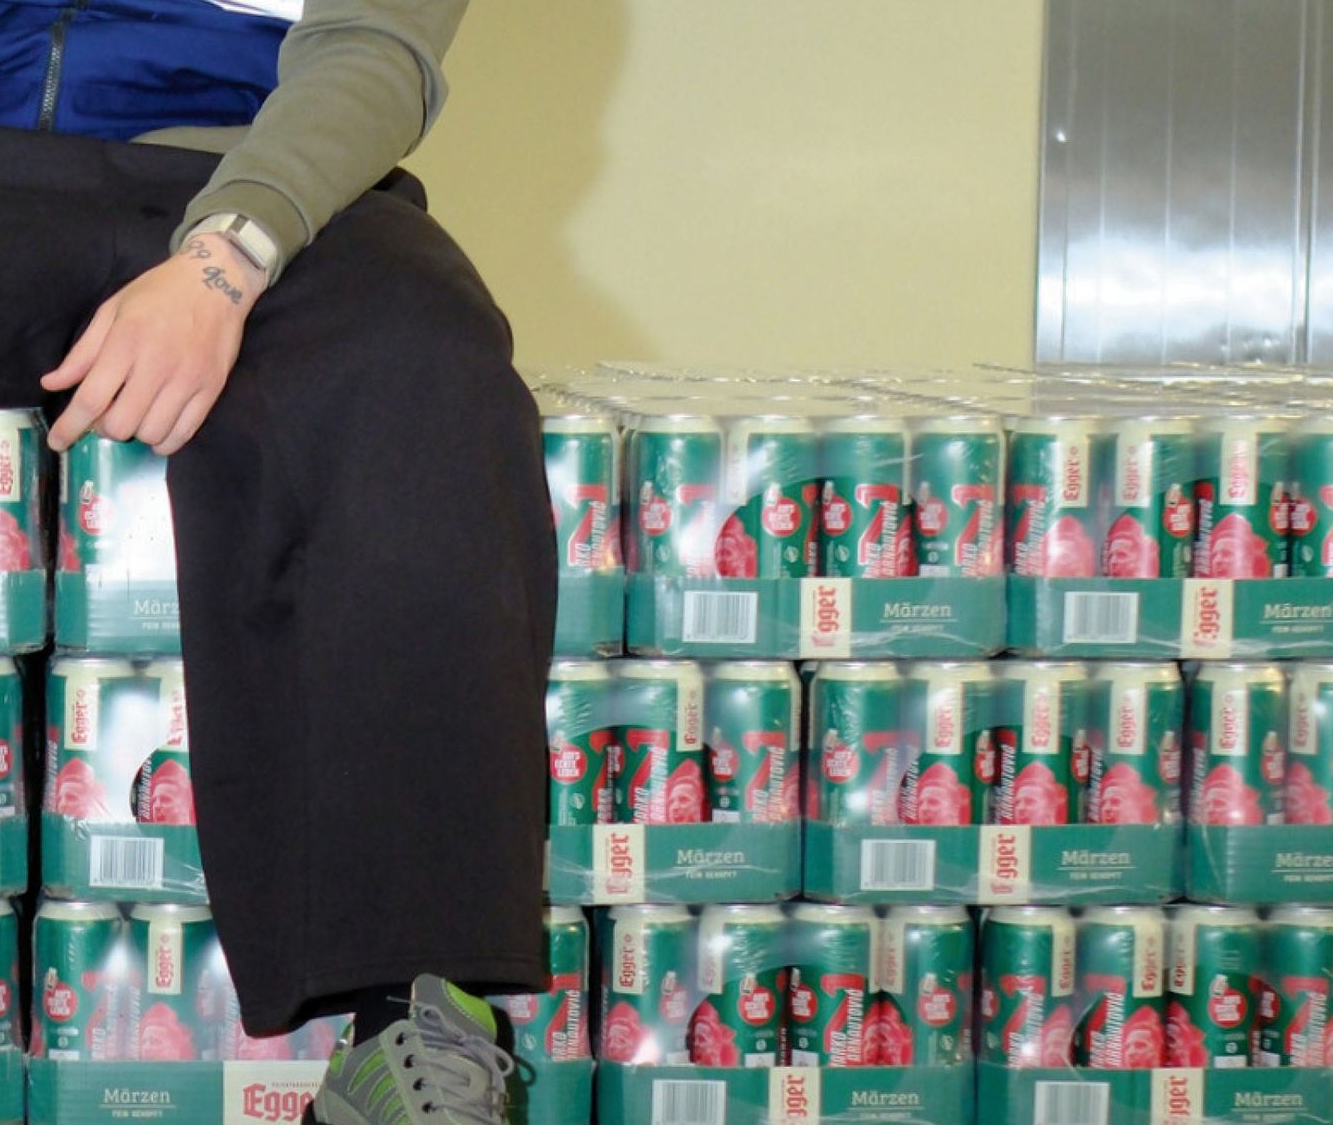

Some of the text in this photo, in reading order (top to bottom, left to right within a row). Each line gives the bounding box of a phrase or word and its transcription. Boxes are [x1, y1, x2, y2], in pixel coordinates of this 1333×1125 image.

[884, 602, 952, 618] Märzen
[676, 848, 746, 864] Märzen
[103, 1087, 171, 1104] Märzen
[851, 1089, 920, 1106] Märzen
[1234, 1091, 1303, 1107] Märzen
